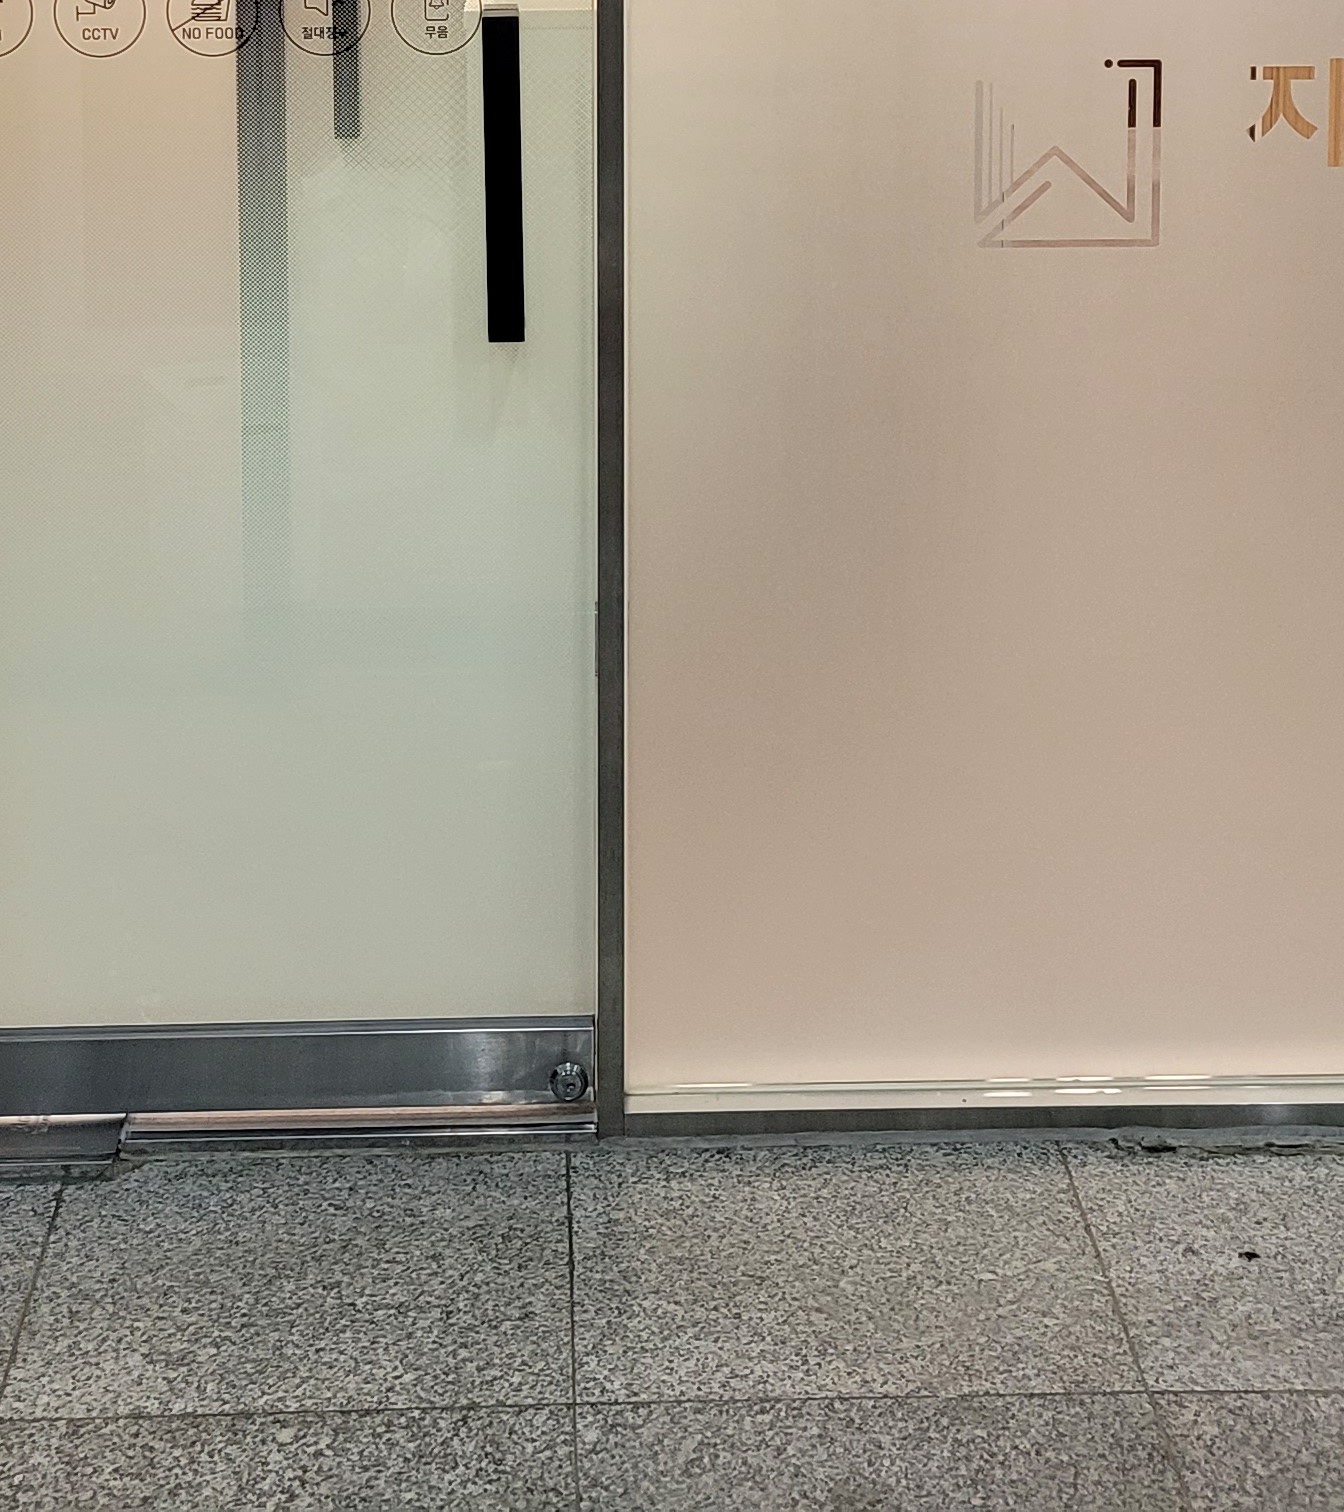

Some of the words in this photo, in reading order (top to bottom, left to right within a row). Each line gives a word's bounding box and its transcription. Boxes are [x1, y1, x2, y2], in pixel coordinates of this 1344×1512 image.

[82, 28, 119, 40] CCTV
[182, 27, 201, 39] NO
[424, 25, 448, 38] 무음
